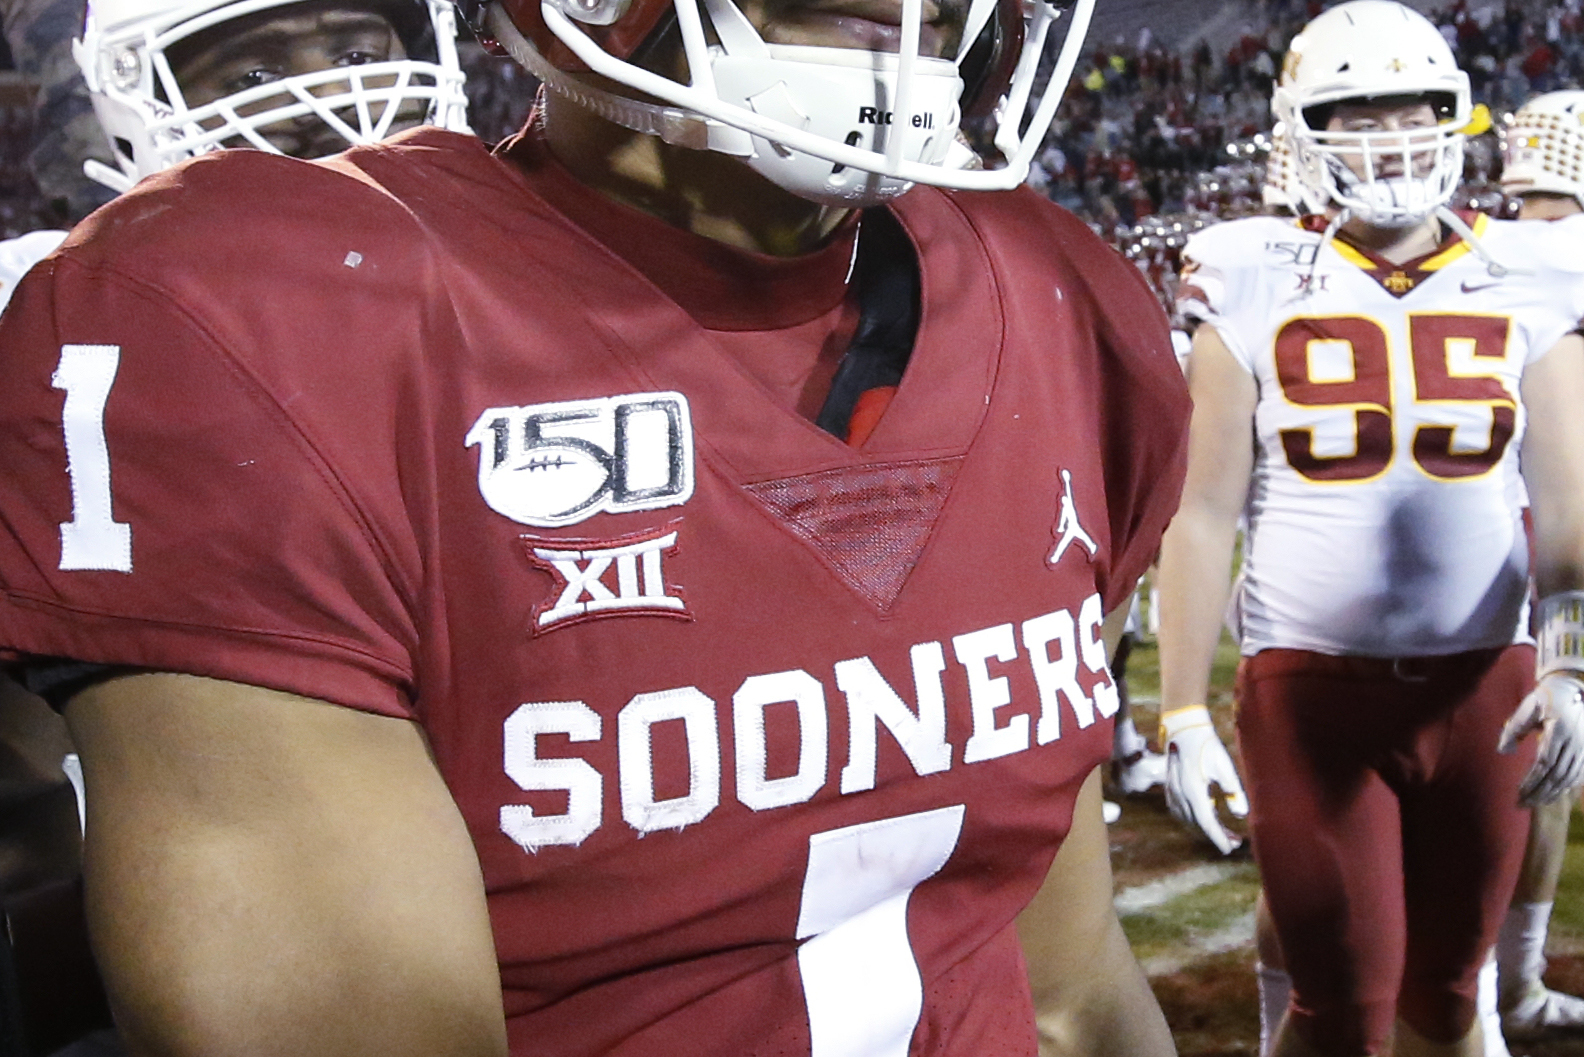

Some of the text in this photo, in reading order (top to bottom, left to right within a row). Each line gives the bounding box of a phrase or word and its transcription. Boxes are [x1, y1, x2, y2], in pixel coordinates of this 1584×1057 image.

[51, 344, 133, 572] 1
[468, 392, 694, 527] 150
[1273, 310, 1518, 485] 95
[533, 530, 686, 626] XII
[499, 593, 1120, 854] SOONERS
